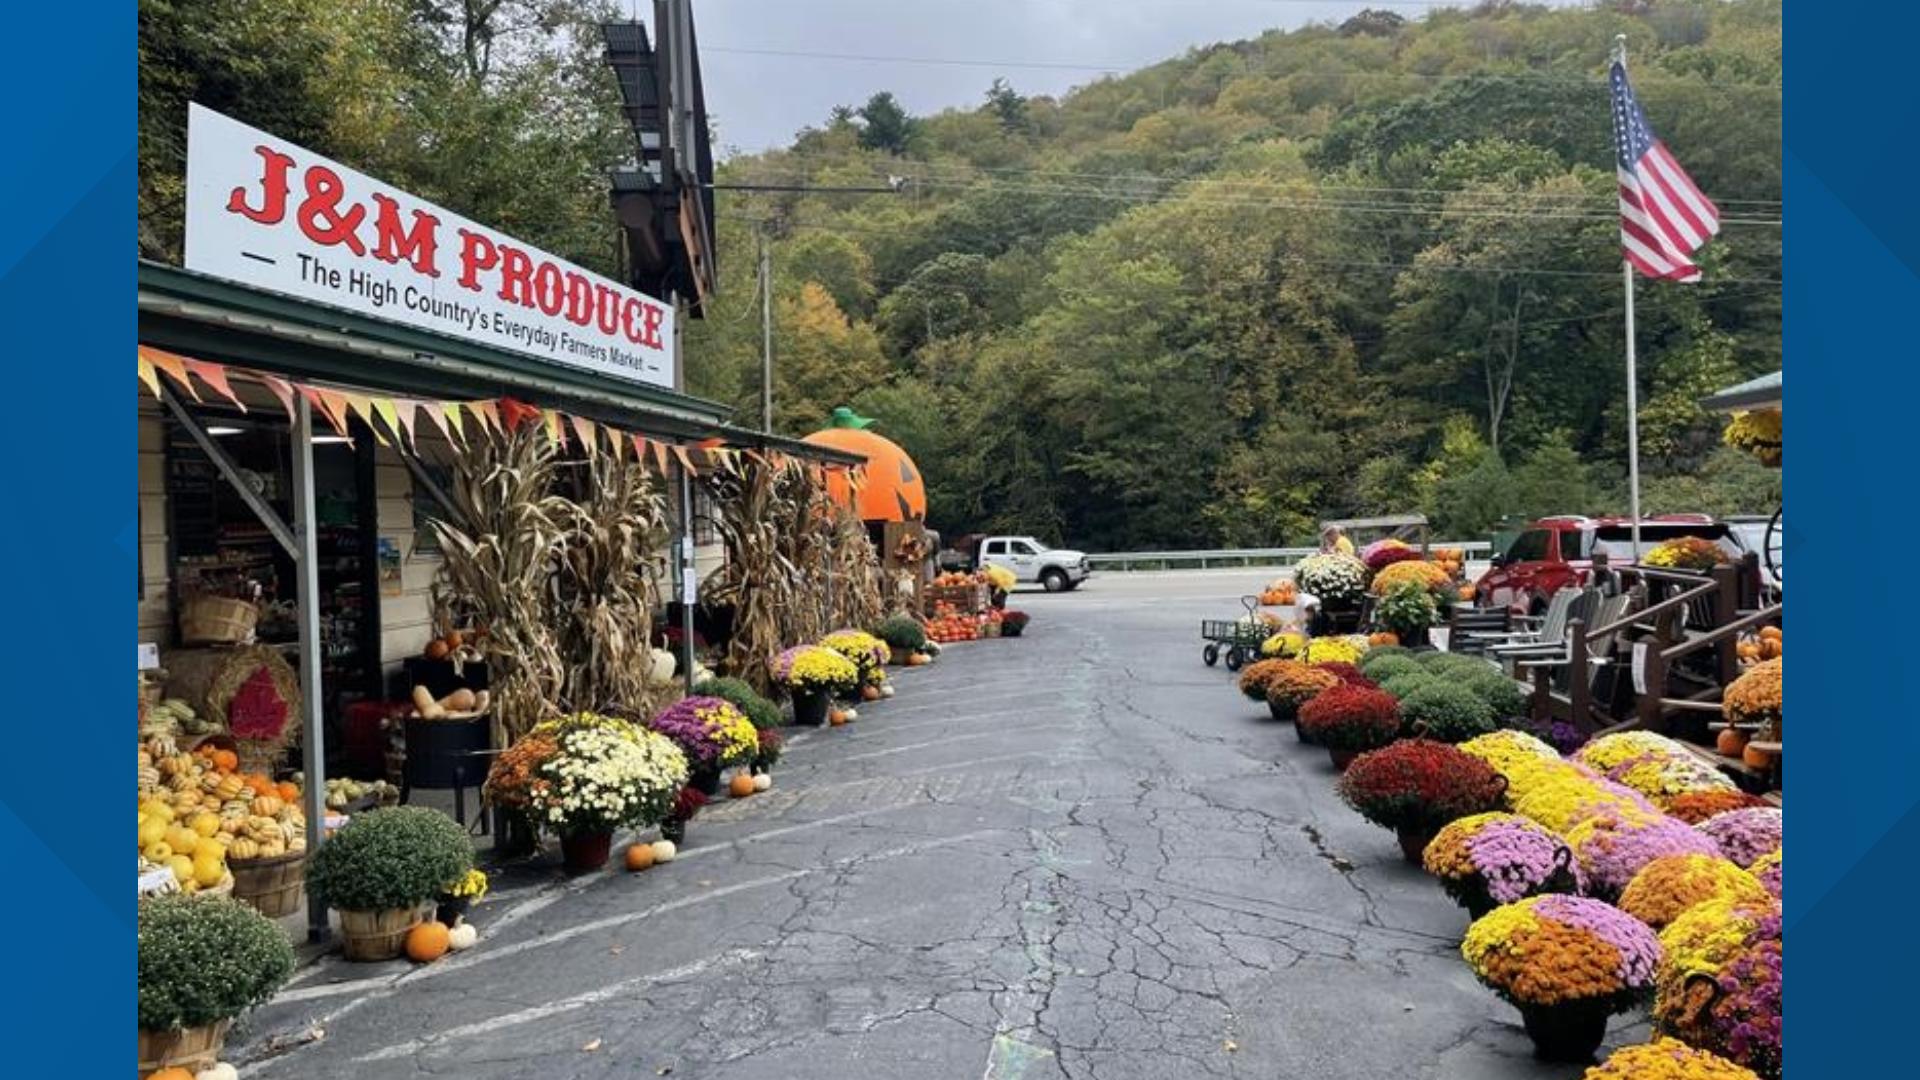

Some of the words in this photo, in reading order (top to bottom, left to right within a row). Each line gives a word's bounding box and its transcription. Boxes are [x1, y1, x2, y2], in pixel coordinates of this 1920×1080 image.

[226, 145, 441, 278] J&M
[457, 227, 665, 351] PRODUCE
[297, 253, 341, 289] The
[349, 268, 397, 307] High
[404, 286, 489, 331] Country's
[493, 312, 558, 352] Everyday
[561, 331, 607, 362] Farmers
[609, 347, 644, 370] Market
